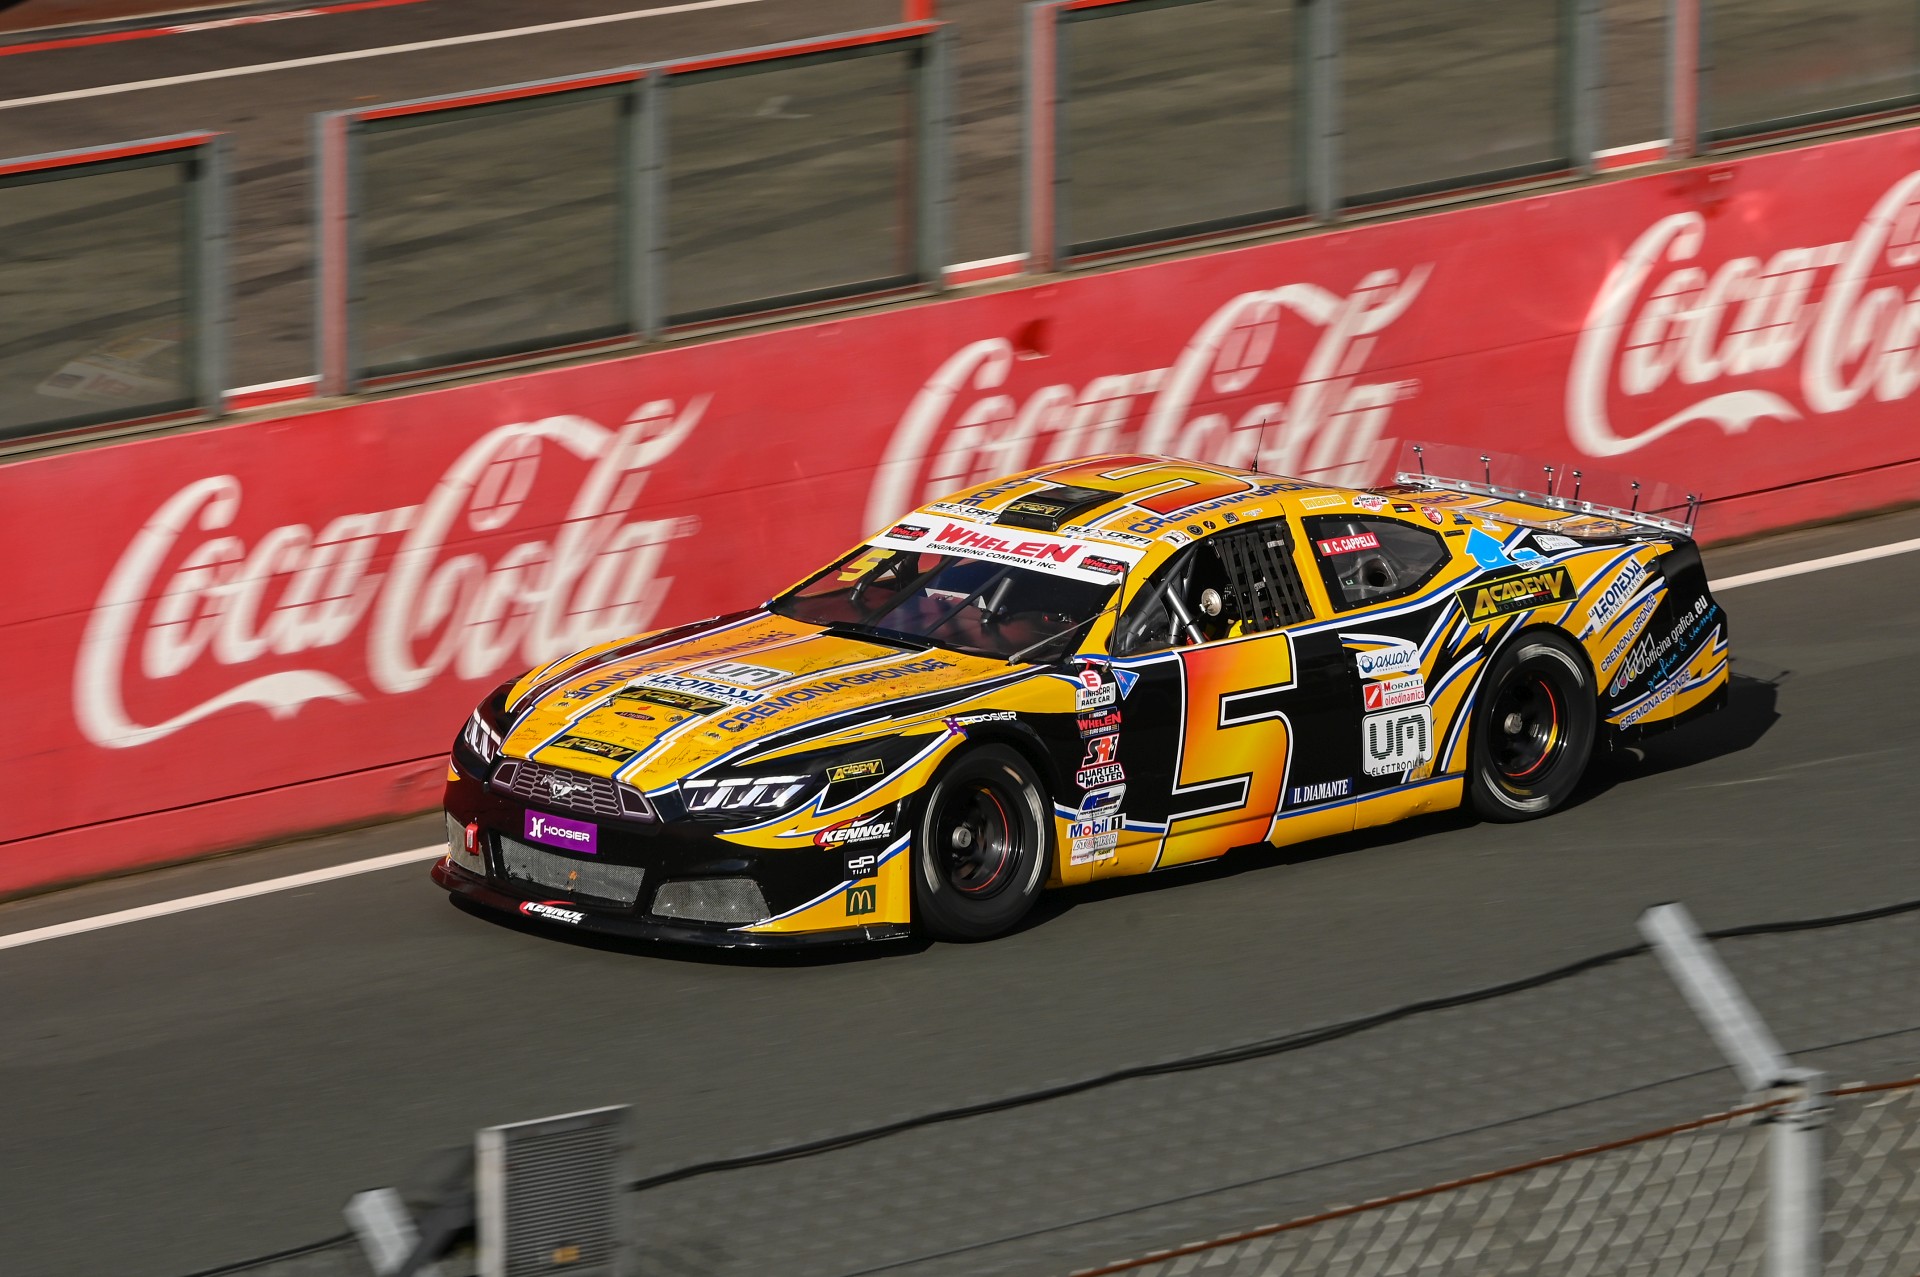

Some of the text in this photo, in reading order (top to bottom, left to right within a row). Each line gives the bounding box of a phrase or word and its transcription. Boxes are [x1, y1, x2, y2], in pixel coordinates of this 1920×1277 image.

[1564, 169, 1920, 457] Coca-Co
[934, 522, 1083, 563] WHELEN
[1332, 535, 1377, 552] C. CAPPELLI
[837, 548, 896, 582] 5
[926, 542, 1058, 570] ENGINEERING COMPANY INC.
[74, 394, 712, 749] Coca-Cola
[1472, 570, 1564, 619] ACADEMY
[1594, 559, 1643, 621] LEONESSA
[1600, 570, 1646, 627] SLEWING BEARINGS
[1600, 593, 1658, 672] CREMONA GRONDE
[1645, 637, 1672, 668] officina
[1679, 637, 1688, 652] &
[648, 674, 765, 703] LEONESSA
[1083, 673, 1098, 687] E
[1384, 678, 1423, 691] MORATTI
[717, 659, 947, 733] CREMONA GRONDE
[1081, 695, 1110, 706] RACE CAR
[1385, 690, 1425, 706] oleodinamica
[1619, 668, 1692, 731] CREMONA GRONDE
[961, 711, 1017, 725] HOOSIER
[1077, 711, 1122, 731] WHELEN
[1149, 632, 1297, 873] 5
[833, 761, 879, 780] ACADEMY
[1077, 764, 1120, 783] QUARTER
[1085, 772, 1123, 788] MASTER
[1293, 780, 1349, 804] IL DIAMANTE
[543, 825, 591, 843] HOOSIER
[820, 822, 892, 843] KENNOL
[1070, 819, 1108, 838] Mobil
[847, 835, 883, 844] PERFORMANCE
[523, 902, 586, 921] KENNOL
